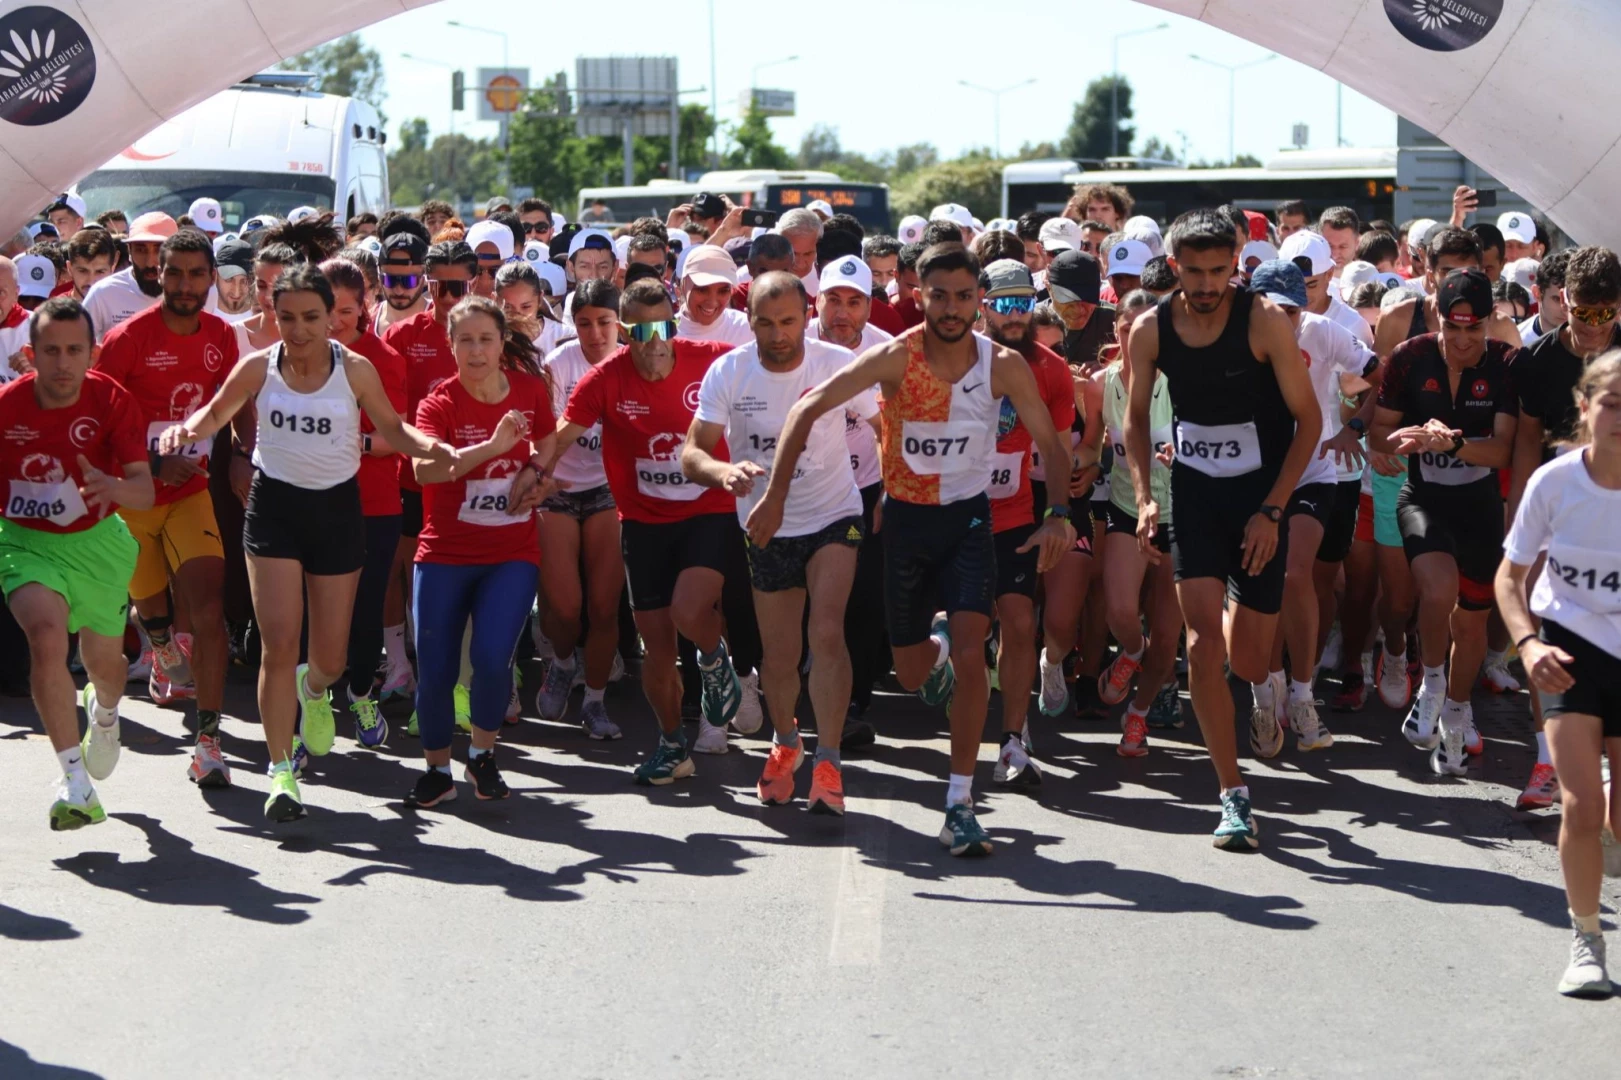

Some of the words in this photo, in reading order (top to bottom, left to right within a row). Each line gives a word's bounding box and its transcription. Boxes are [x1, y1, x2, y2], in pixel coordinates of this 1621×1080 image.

[1441, 0, 1488, 27] BELEDİYESİ
[0, 70, 42, 104] ARABAĞLAR
[41, 39, 85, 75] BELEDİYESİ
[270, 410, 331, 435] 0138
[904, 436, 970, 457] 0677
[1181, 440, 1241, 459] 0673
[991, 469, 1011, 485] 48
[10, 496, 66, 518] 0808
[469, 495, 508, 511] 128
[1548, 556, 1620, 593] 0214
